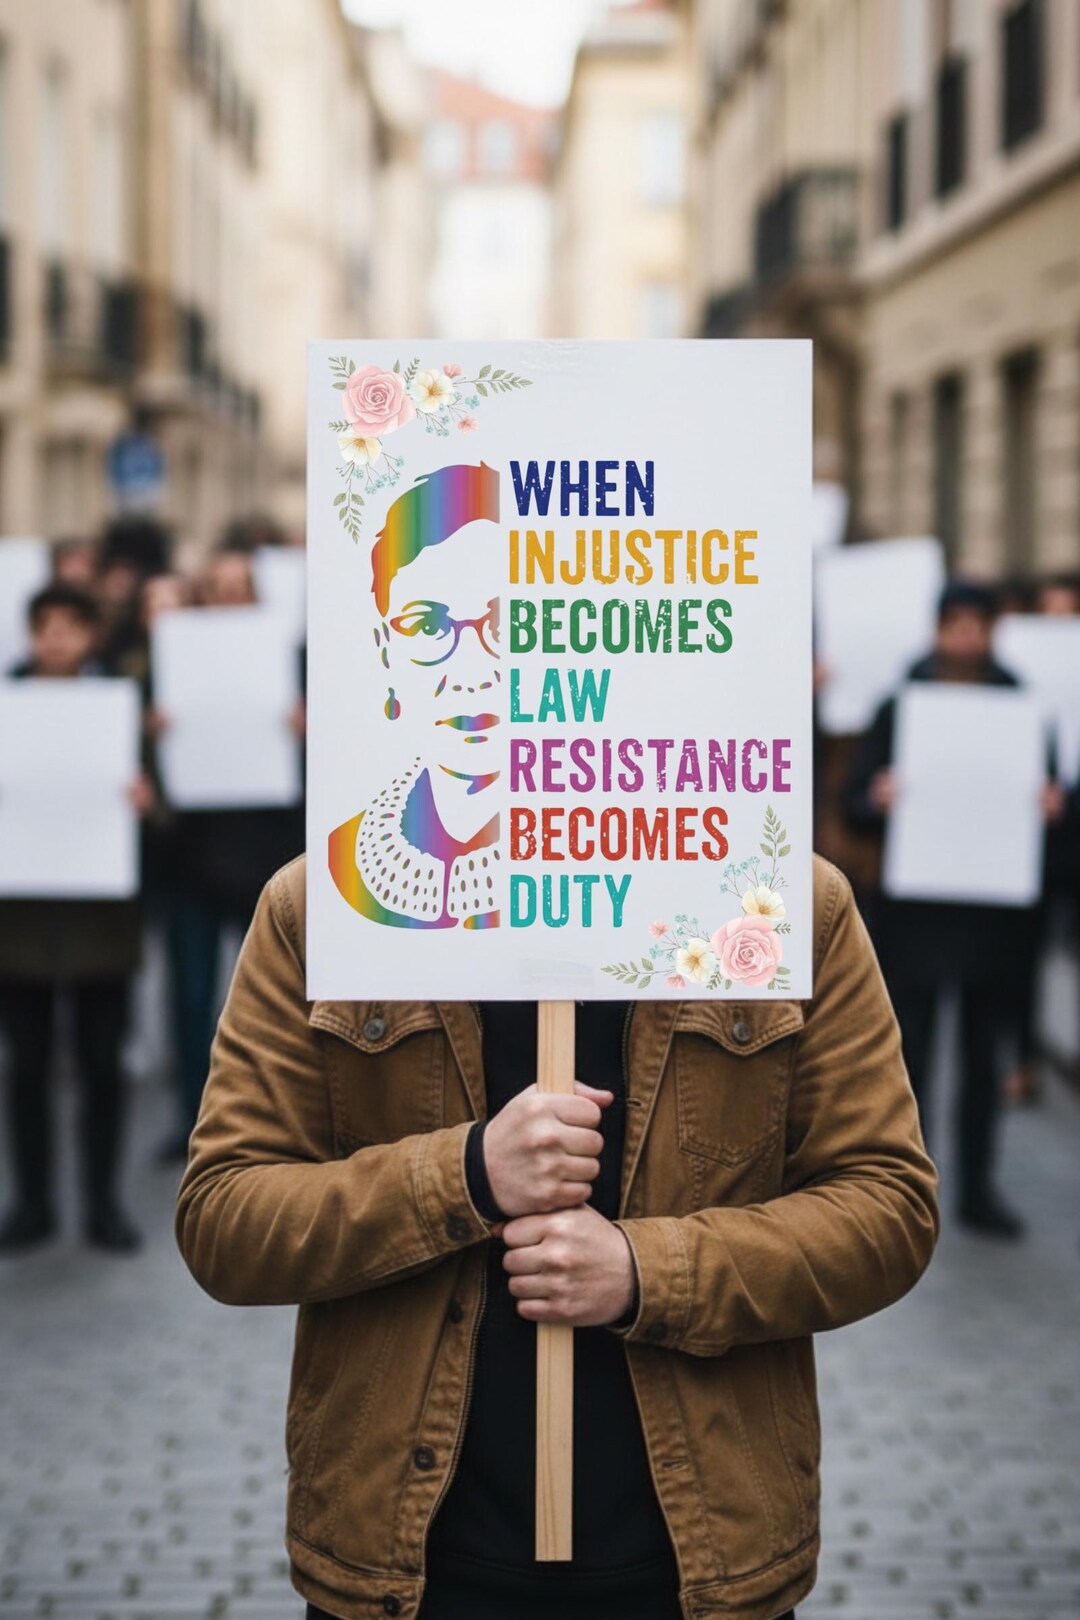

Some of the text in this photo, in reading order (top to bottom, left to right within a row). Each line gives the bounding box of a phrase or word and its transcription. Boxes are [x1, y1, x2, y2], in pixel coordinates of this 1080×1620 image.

[510, 461, 654, 516] WHEN
[509, 529, 759, 585] INJUSTICE
[511, 599, 732, 653] BECOMES
[510, 668, 610, 722] LAW
[511, 739, 790, 792] RESISTANCE
[510, 807, 728, 861] BECOMES
[510, 874, 631, 928] DUTY
